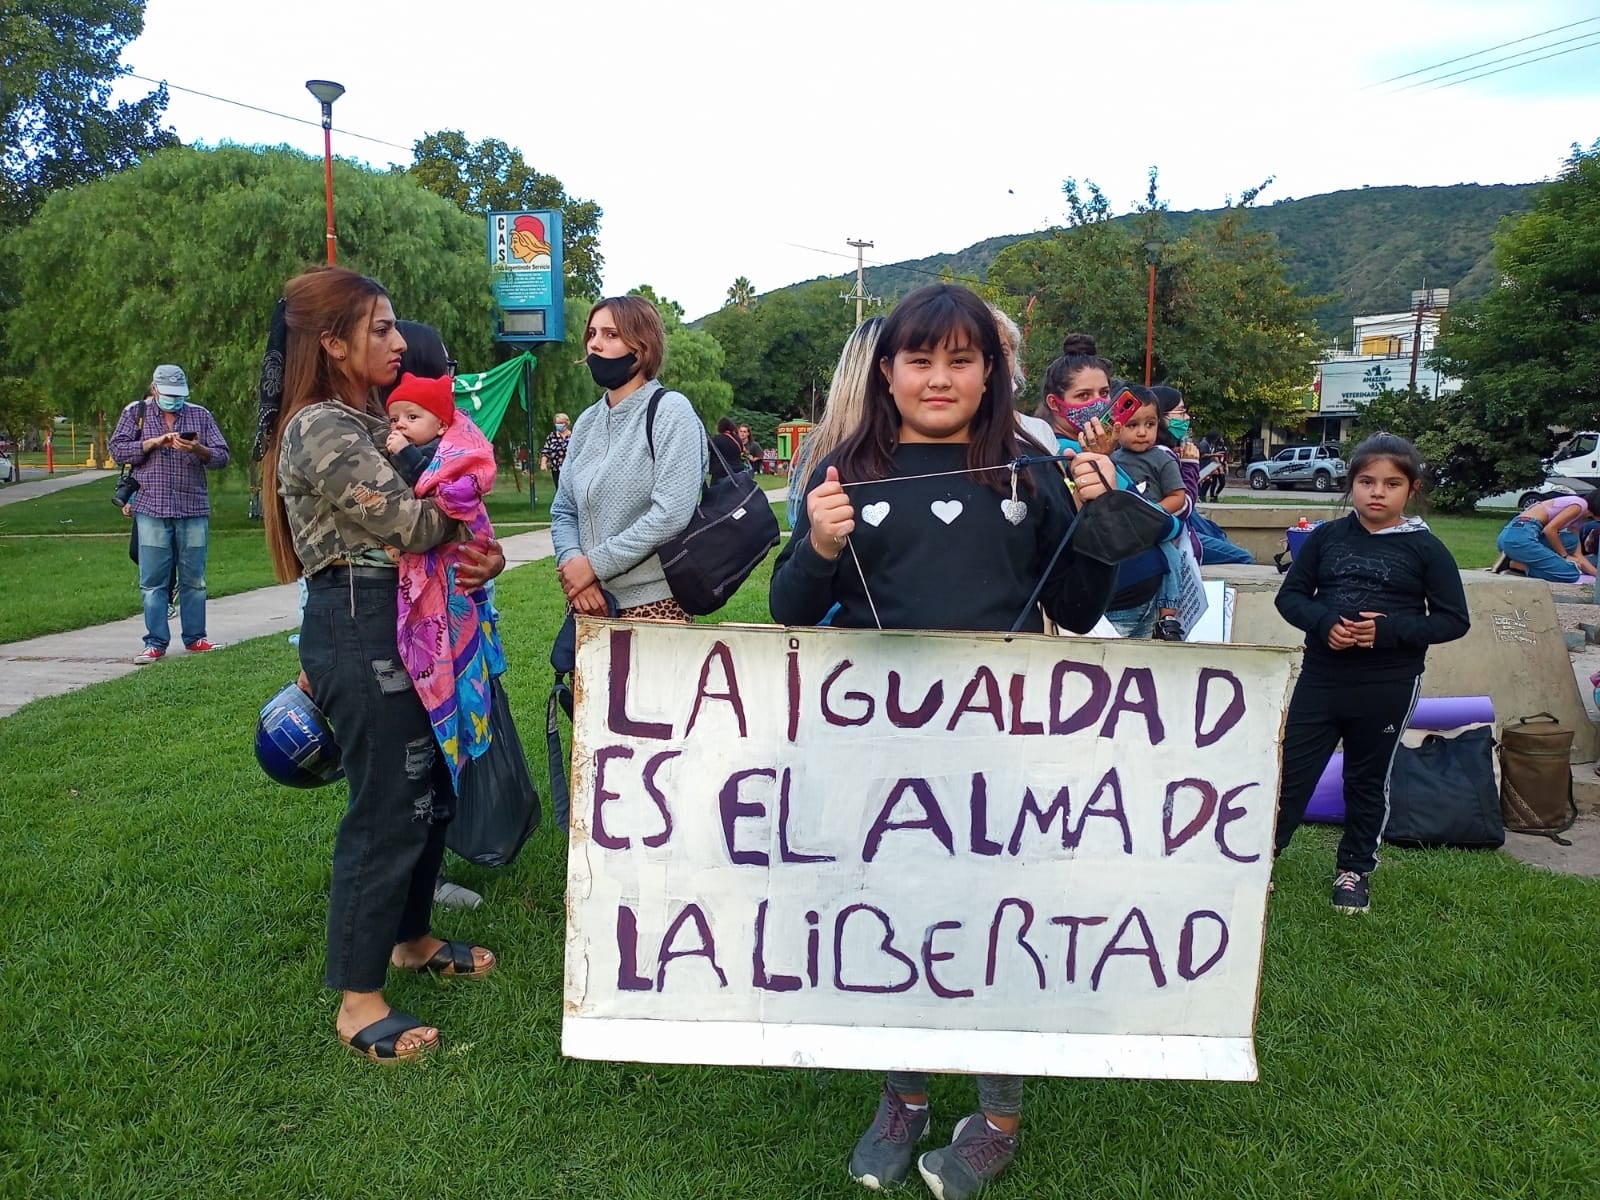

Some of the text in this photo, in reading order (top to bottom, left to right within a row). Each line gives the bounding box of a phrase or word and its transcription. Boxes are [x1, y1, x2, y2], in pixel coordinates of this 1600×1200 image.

[608, 629, 747, 739] LA
[592, 745, 1260, 865] ES EL ALMA DE
[617, 904, 728, 992] LA
